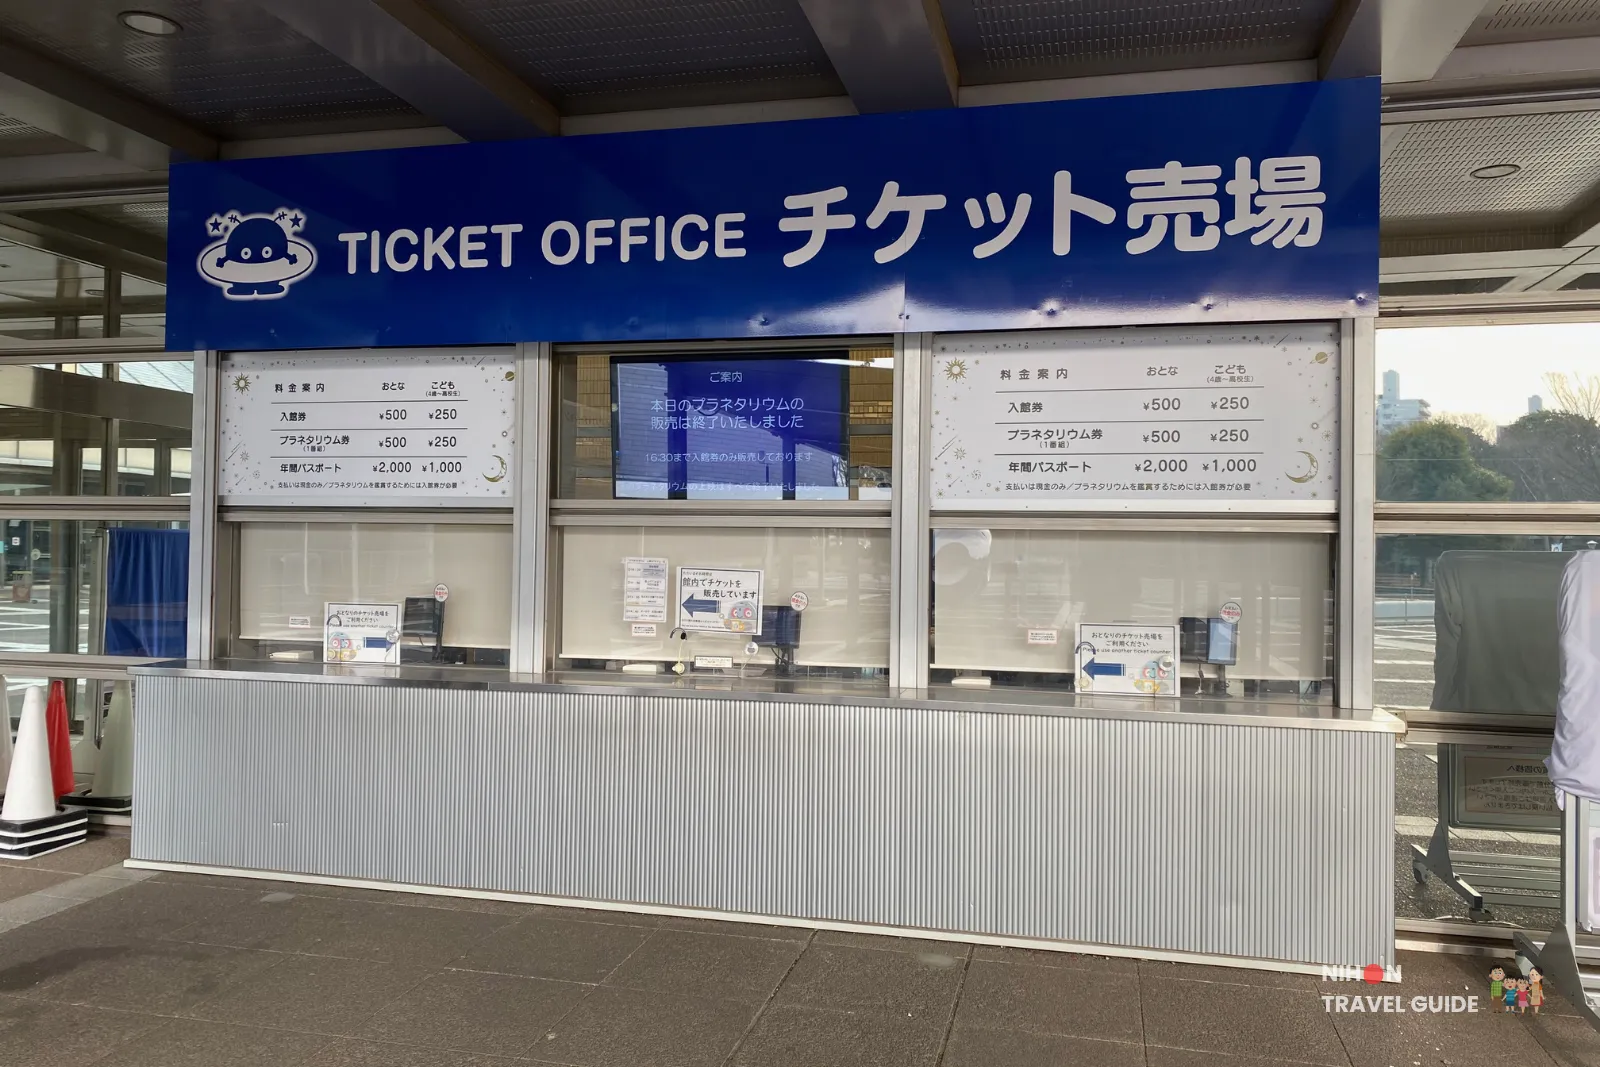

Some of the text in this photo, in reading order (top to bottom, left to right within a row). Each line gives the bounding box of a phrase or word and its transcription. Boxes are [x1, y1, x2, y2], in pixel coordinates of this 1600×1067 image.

[779, 155, 1326, 268] チケット売場
[337, 212, 747, 275] TICKET OFFICE
[1146, 365, 1178, 376] おとな
[1214, 364, 1246, 375] こども
[710, 372, 743, 382] ご案内
[382, 382, 406, 391] おとな
[431, 381, 455, 390] こども
[650, 397, 804, 412] 本日のプラネタリウムの
[1008, 402, 1043, 413] 入館券
[1143, 397, 1181, 412] ¥500
[1210, 396, 1250, 410] ¥250
[280, 412, 306, 422] 入館券
[379, 408, 407, 421] ¥500
[428, 408, 458, 420] ¥250
[650, 414, 804, 429] 販売は終了いたしました
[1008, 428, 1102, 440] プラネタリウム券
[1142, 430, 1180, 444] ¥500
[1210, 429, 1249, 443] ¥250
[280, 436, 350, 445] プラネタリウム券
[378, 437, 406, 448] ¥500
[428, 436, 456, 448] ¥250
[280, 463, 341, 474] 年間パスポート
[372, 462, 412, 474] ¥2,000
[422, 461, 462, 474] ¥1,000
[1008, 460, 1092, 473] 年間パスポート
[1134, 459, 1188, 474] ¥2,000
[1202, 458, 1256, 473] ¥1,000
[682, 578, 742, 588] 館内でチケットを
[704, 589, 757, 600] 販売しています
[1092, 632, 1164, 640] おとなりのチケット売場を
